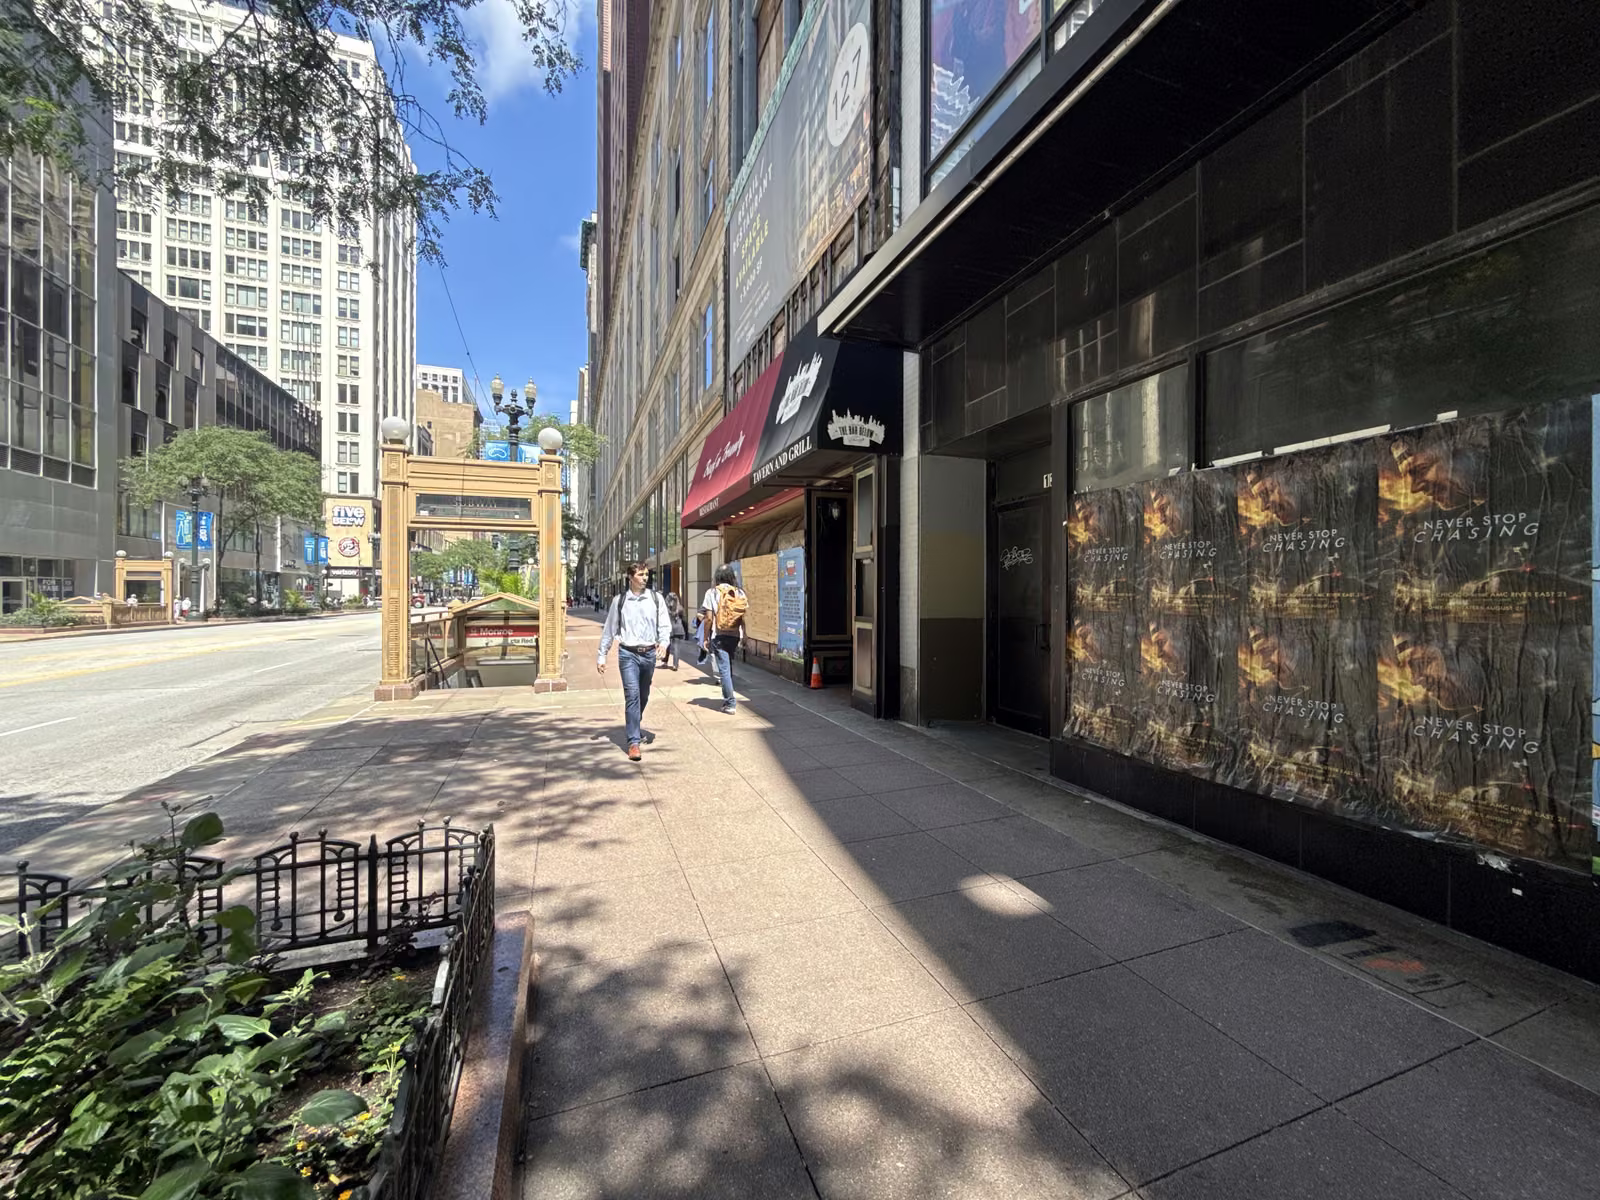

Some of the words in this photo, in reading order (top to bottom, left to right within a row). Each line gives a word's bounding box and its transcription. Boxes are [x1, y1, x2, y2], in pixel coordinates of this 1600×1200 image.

[833, 44, 862, 121] 127
[733, 162, 773, 256] RESTAURANT
[741, 213, 761, 260] SPACE
[735, 219, 769, 291] AVAILABLE
[838, 425, 848, 436] THE
[848, 424, 858, 436] BAR
[859, 424, 875, 439] BELOW
[752, 459, 775, 485] TAVERN
[773, 452, 788, 472] AND
[788, 436, 812, 462] GRILL
[332, 505, 366, 519] five
[332, 517, 366, 527] BELOW
[1423, 516, 1475, 531] NEVER
[1482, 512, 1527, 526] STOP
[1269, 531, 1303, 541] NEVER
[1308, 528, 1338, 539] STOP
[1413, 522, 1540, 544] CHASING
[1087, 547, 1106, 555] NEVER
[1108, 546, 1125, 554] STOP
[1163, 541, 1186, 550] NEVER
[1188, 540, 1211, 549] STOP
[1262, 537, 1345, 553] CHASING
[1083, 552, 1129, 563] CHASING
[1159, 547, 1217, 560] CHASING
[331, 568, 358, 578] verizon
[480, 627, 514, 637] Monroe
[1081, 673, 1126, 687] CHASING
[1085, 667, 1104, 676] NEVER
[1105, 668, 1121, 677] STOP
[1161, 679, 1184, 690] NEVER
[1185, 683, 1208, 693] STOP
[1157, 687, 1216, 703] CHASING
[1269, 695, 1303, 706] NEVER
[1307, 700, 1337, 711] STOP
[1262, 702, 1344, 723] CHASING
[1423, 716, 1474, 731] NEVER
[1482, 723, 1527, 738] STOP
[1413, 725, 1539, 754] CHASING
[1490, 802, 1509, 811] AMC
[1510, 806, 1532, 816] RIVER
[1534, 810, 1554, 821] EAST
